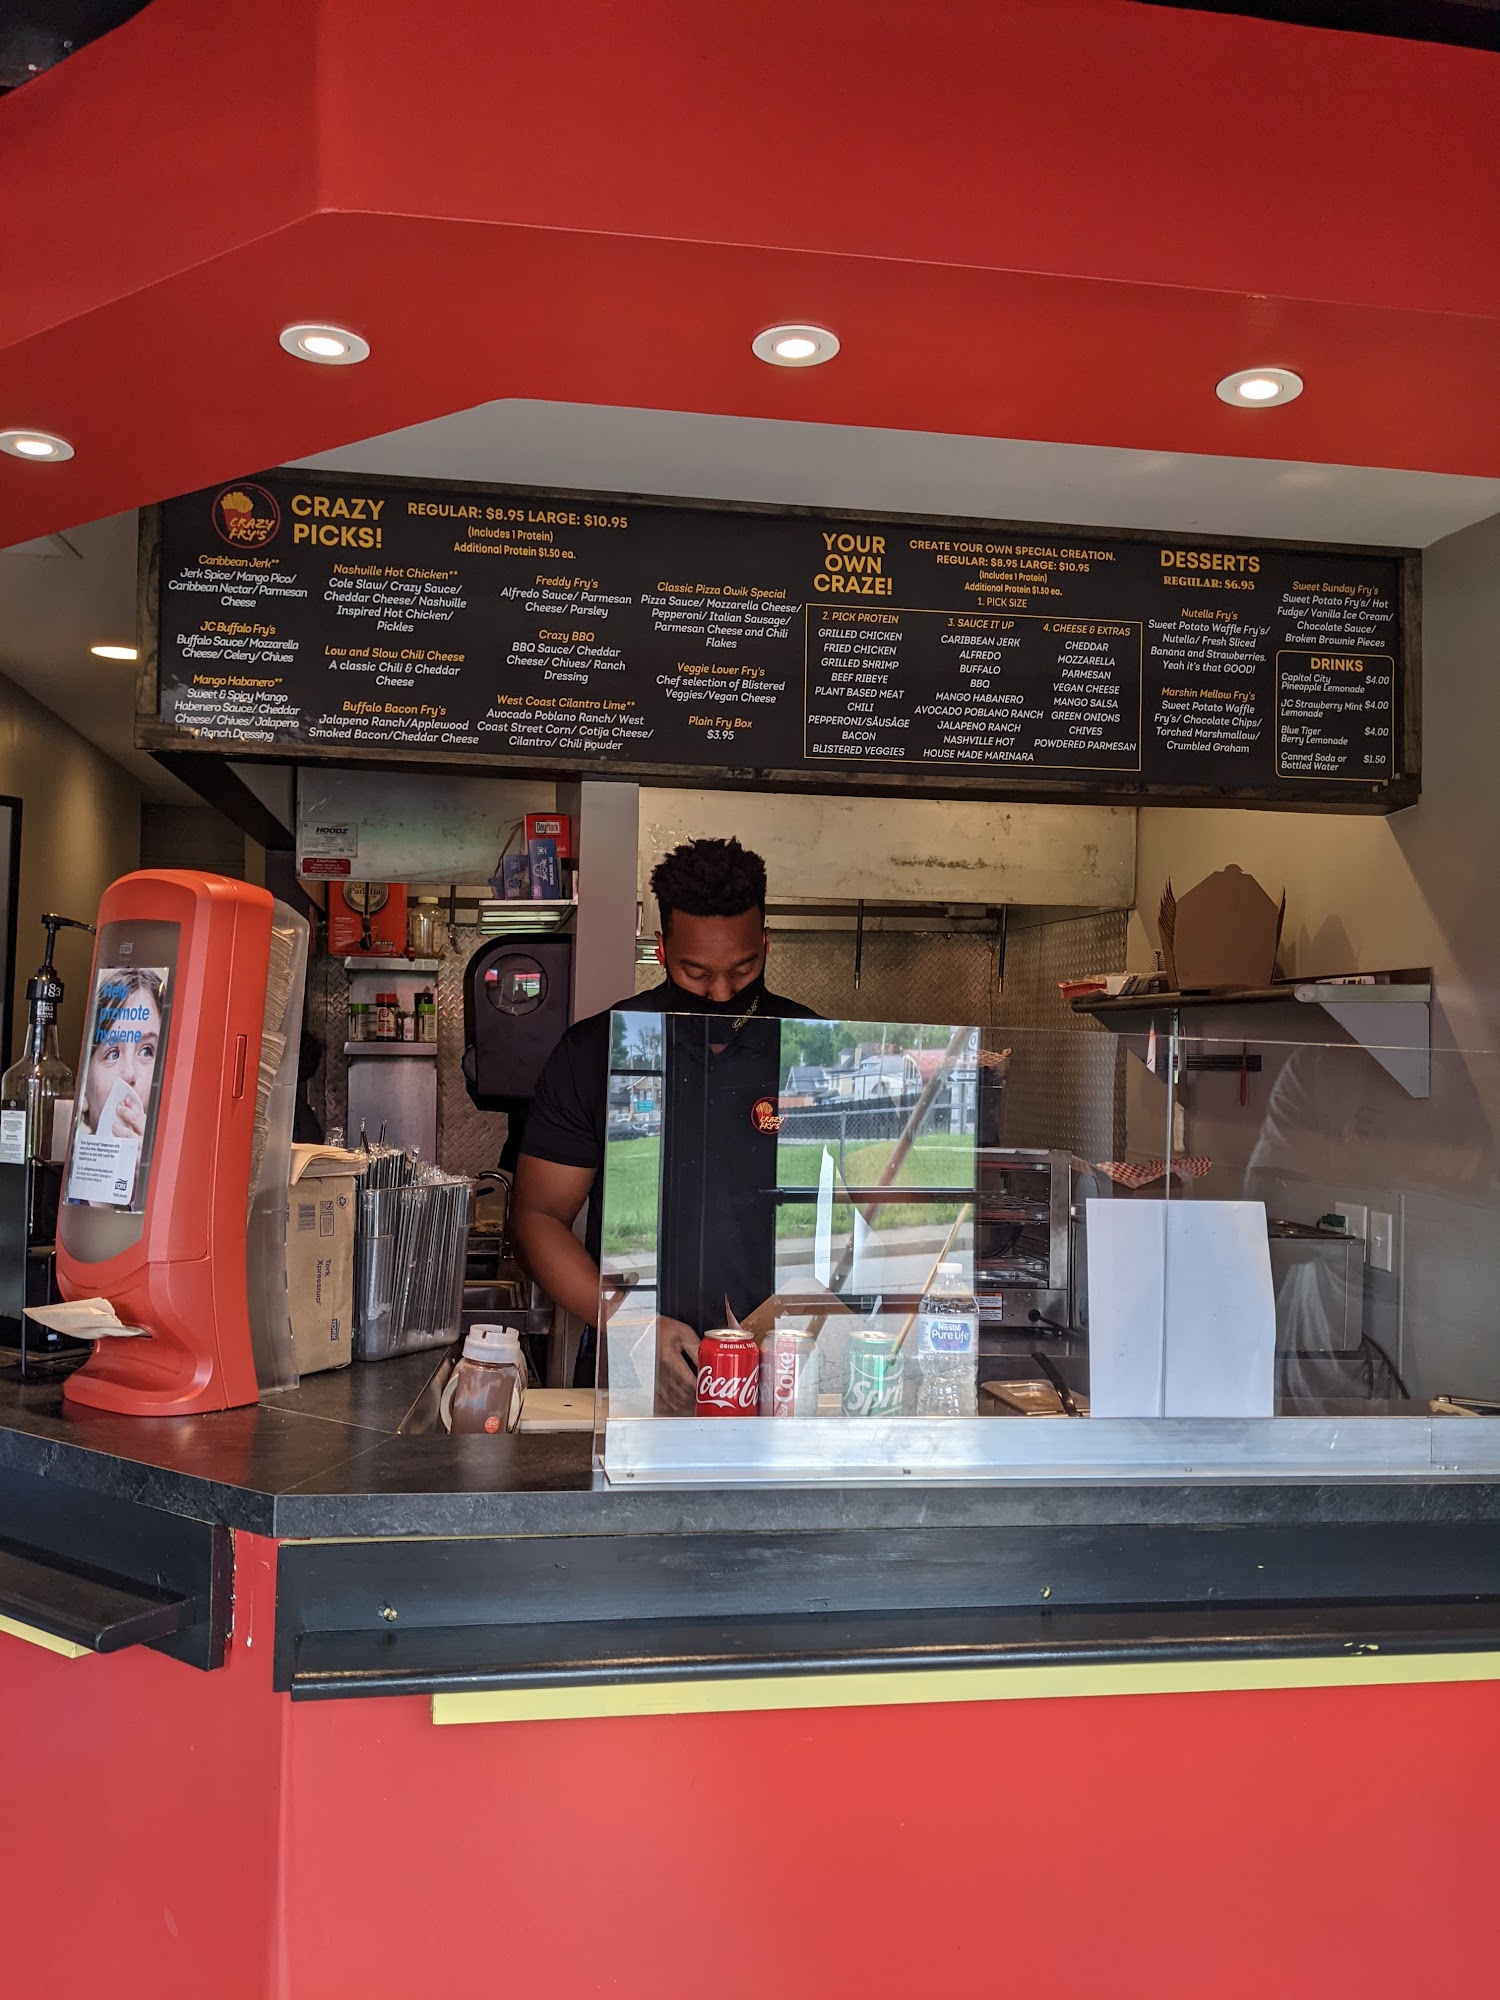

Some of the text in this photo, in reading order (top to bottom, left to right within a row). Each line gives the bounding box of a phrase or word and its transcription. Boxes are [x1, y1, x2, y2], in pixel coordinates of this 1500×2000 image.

[291, 494, 385, 521] CRAZY
[407, 501, 628, 529] REGULAR: $8.95 LARGE: $10.95
[229, 517, 276, 531] CRAZY
[228, 528, 268, 542] FRY'S
[293, 523, 382, 549] PICKS!
[467, 525, 554, 543] (Includes 1 Protein)
[453, 541, 576, 559] Additional Protein $1.50 ea.
[822, 532, 886, 555] YOUR
[908, 539, 1116, 561] CREATE YOUR OWN SPECIAL CREATION.
[198, 554, 249, 567] Caribbean
[824, 553, 882, 574] OWN
[1160, 549, 1260, 573] DESSERTS
[332, 563, 383, 576] Nashville
[384, 566, 405, 578] Hot
[535, 574, 599, 591] Freddy Fry's
[813, 573, 892, 596] CRAZE!
[1162, 575, 1255, 590] REGULAR: $6.95
[1291, 580, 1379, 598] Sweet Sunday Fry's
[656, 581, 787, 600] Classic Pizza Qwik Special
[220, 595, 257, 608] Cheese
[323, 590, 467, 608] Cheddar Cheese/ Nashville
[977, 596, 1028, 608] 1. PICK SIZE
[821, 610, 899, 624] 2. PICK PROTEIN
[1180, 607, 1238, 623] Nutella Fry's
[199, 620, 276, 637] JC Buffalo Fry's
[376, 620, 414, 632] Pickles
[947, 617, 1015, 630] 3. SAUCE IT UP
[1042, 622, 1131, 637] 4. CHEESE & EXTRAS
[176, 633, 299, 650] Buffalo Sauce/ Mozzarella
[538, 629, 595, 644] Crazy BBQ
[705, 636, 738, 649] Flakes
[324, 644, 465, 662] Low and Slow Chili Cheese
[823, 642, 897, 656] FRIED CHICKEN
[1064, 640, 1109, 652] CHEDDAR
[958, 649, 1002, 661] ALFREDO
[1057, 654, 1116, 666] MOZZARELLA
[677, 661, 765, 678] Veggie Lover Fry's
[959, 663, 1001, 675] BUFFALO
[1310, 656, 1364, 672] DRINKS
[192, 673, 227, 688] Mango
[543, 669, 589, 685] Dressing
[1061, 668, 1112, 680] PARMESAN
[1280, 671, 1331, 686] Capitol City
[1365, 675, 1389, 685] $4.00
[969, 678, 990, 689] BBQ
[186, 687, 289, 705] Sweet & Spicy Mango
[496, 694, 524, 706] West
[524, 695, 557, 707] Coast
[558, 697, 601, 709] Cilantro
[1160, 686, 1256, 703] Marshin Mellow Fry's
[342, 700, 447, 718] Buffalo Bacon Fry's
[846, 701, 875, 712] CHILI
[1280, 707, 1324, 718] Lemonade
[688, 715, 753, 730] Plain Fry Box
[706, 728, 735, 740] $3.95
[841, 730, 877, 741] BACON
[1068, 725, 1103, 736] CHIVES
[1280, 724, 1322, 738] Blue Tiger
[1364, 727, 1389, 736] $4.00
[1280, 751, 1348, 763] Canned Soda or
[1362, 753, 1387, 764] $1.50
[1280, 759, 1340, 771] Bottled Water
[536, 822, 560, 833] DayMark
[349, 887, 381, 895] Padlla
[102, 982, 131, 1002] Help
[97, 1004, 150, 1024] promote
[96, 1026, 142, 1046] hygiene
[760, 1116, 784, 1124] CRAZY
[324, 1258, 332, 1277] Tork
[931, 1330, 970, 1343] Pure Life
[775, 1352, 795, 1403] Coke
